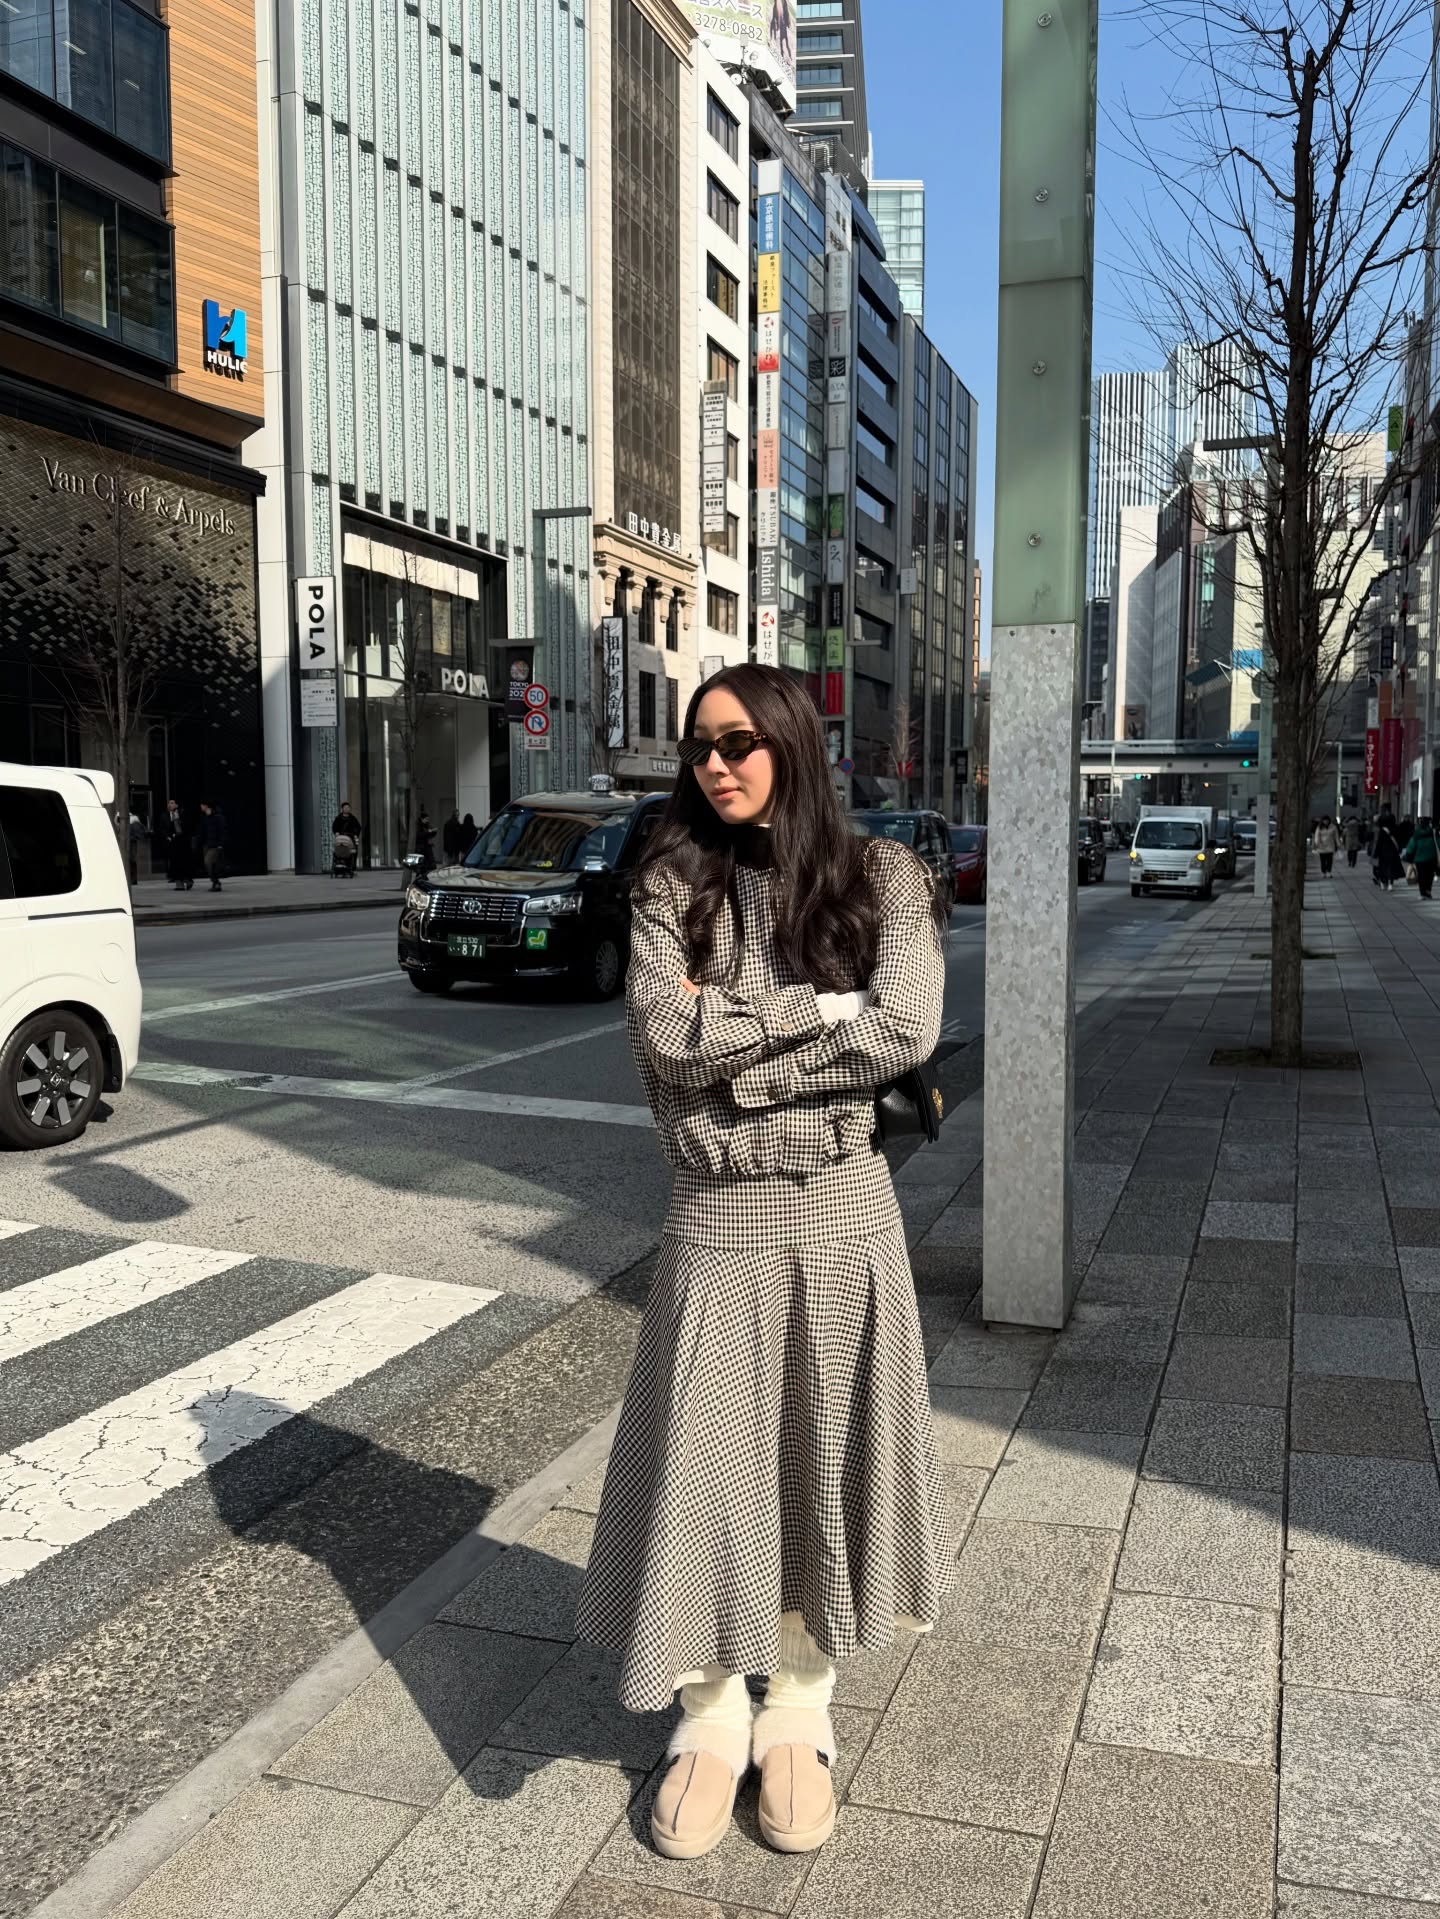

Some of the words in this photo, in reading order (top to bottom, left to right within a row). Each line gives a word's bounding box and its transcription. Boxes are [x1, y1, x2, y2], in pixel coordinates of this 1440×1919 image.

[695, 12, 763, 41] 3278-0882
[207, 350, 248, 374] HULIC
[40, 456, 87, 495] Van
[92, 472, 150, 512] Cleef
[156, 496, 169, 519] &
[175, 497, 235, 536] Arpels
[628, 511, 681, 555] 田中貴金属
[761, 550, 775, 596] Ishida
[308, 585, 326, 660] POLA
[441, 667, 489, 699] POLA
[529, 690, 544, 702] 50
